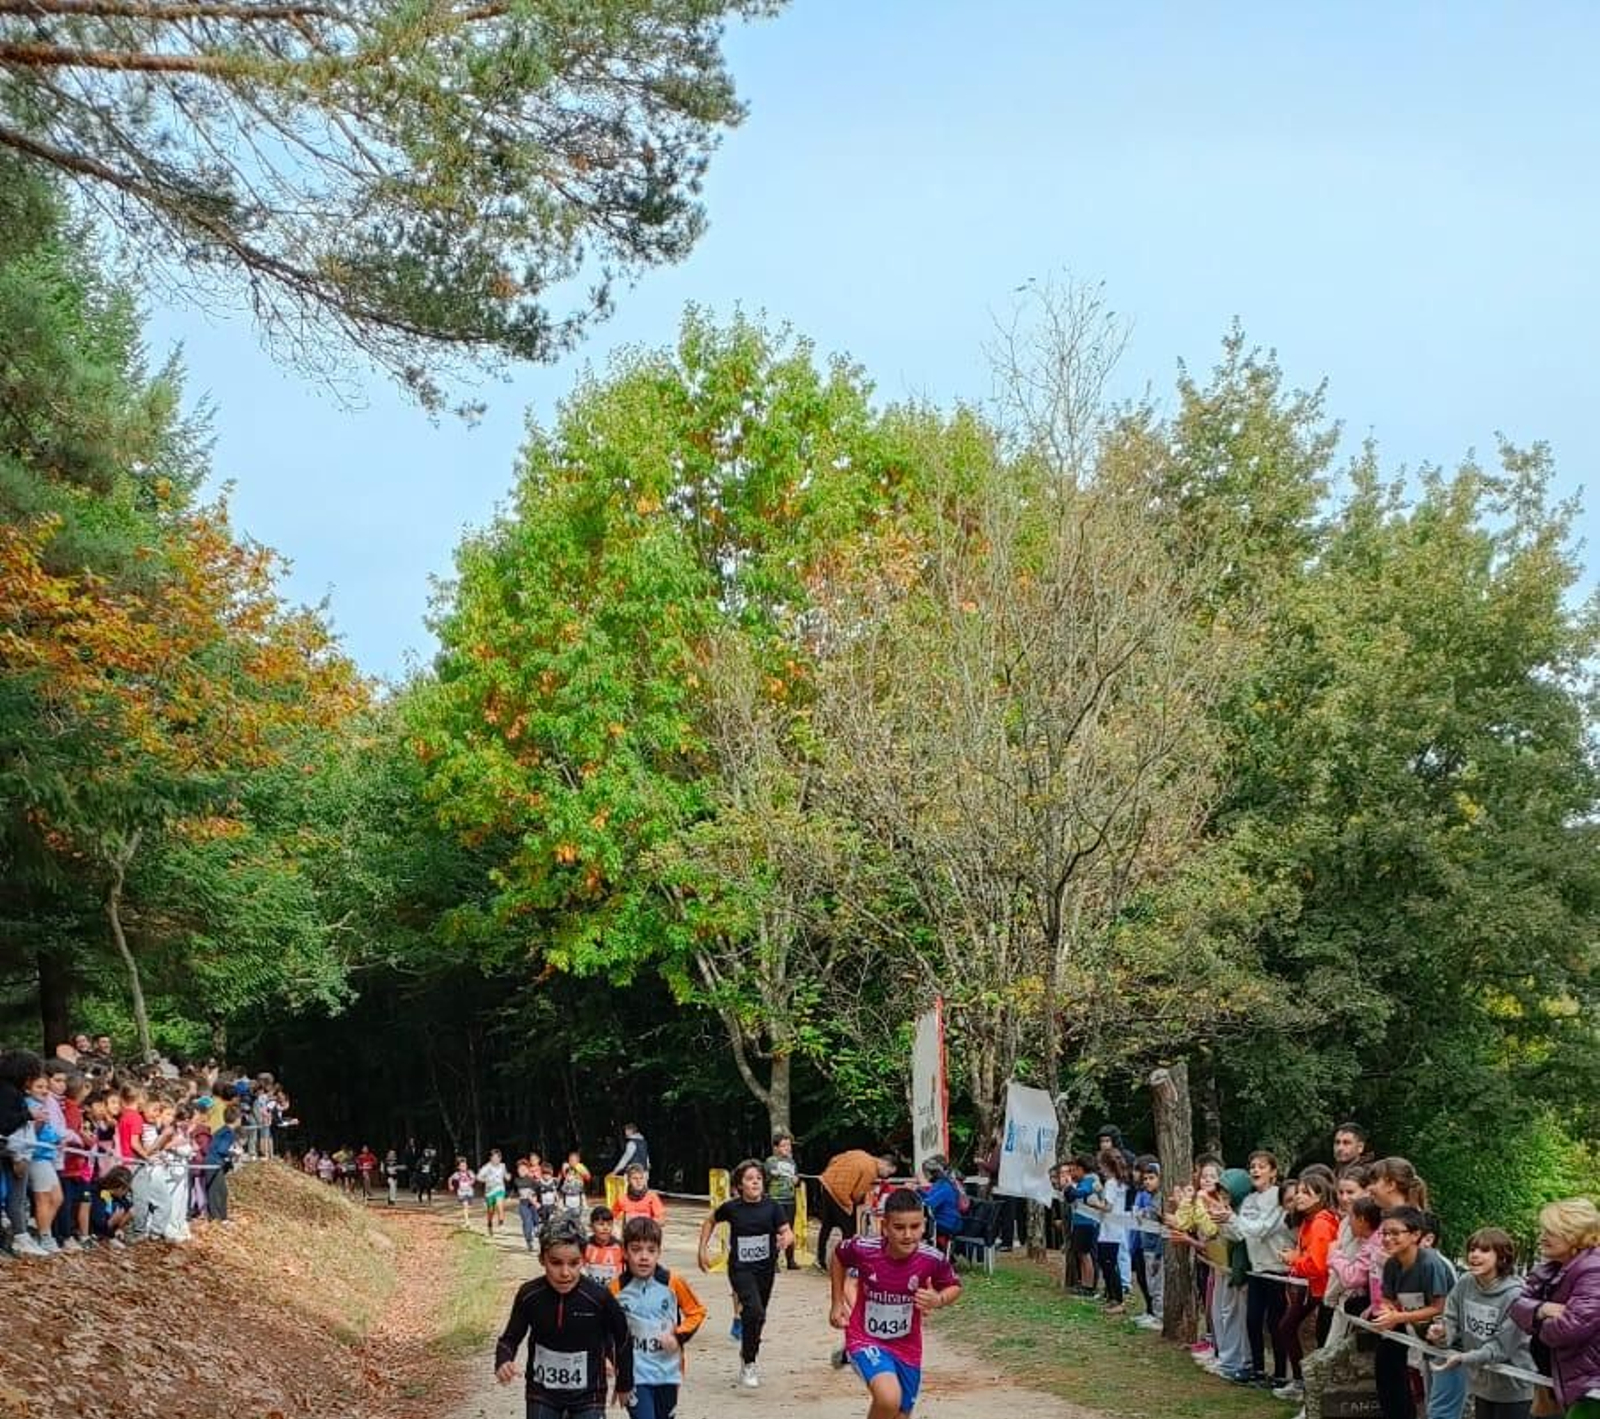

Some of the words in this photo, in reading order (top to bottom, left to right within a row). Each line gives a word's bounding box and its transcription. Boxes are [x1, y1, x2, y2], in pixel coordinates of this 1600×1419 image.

[868, 1317, 908, 1334] 0434
[633, 1338, 664, 1352] 043
[536, 1365, 582, 1385] 0384
